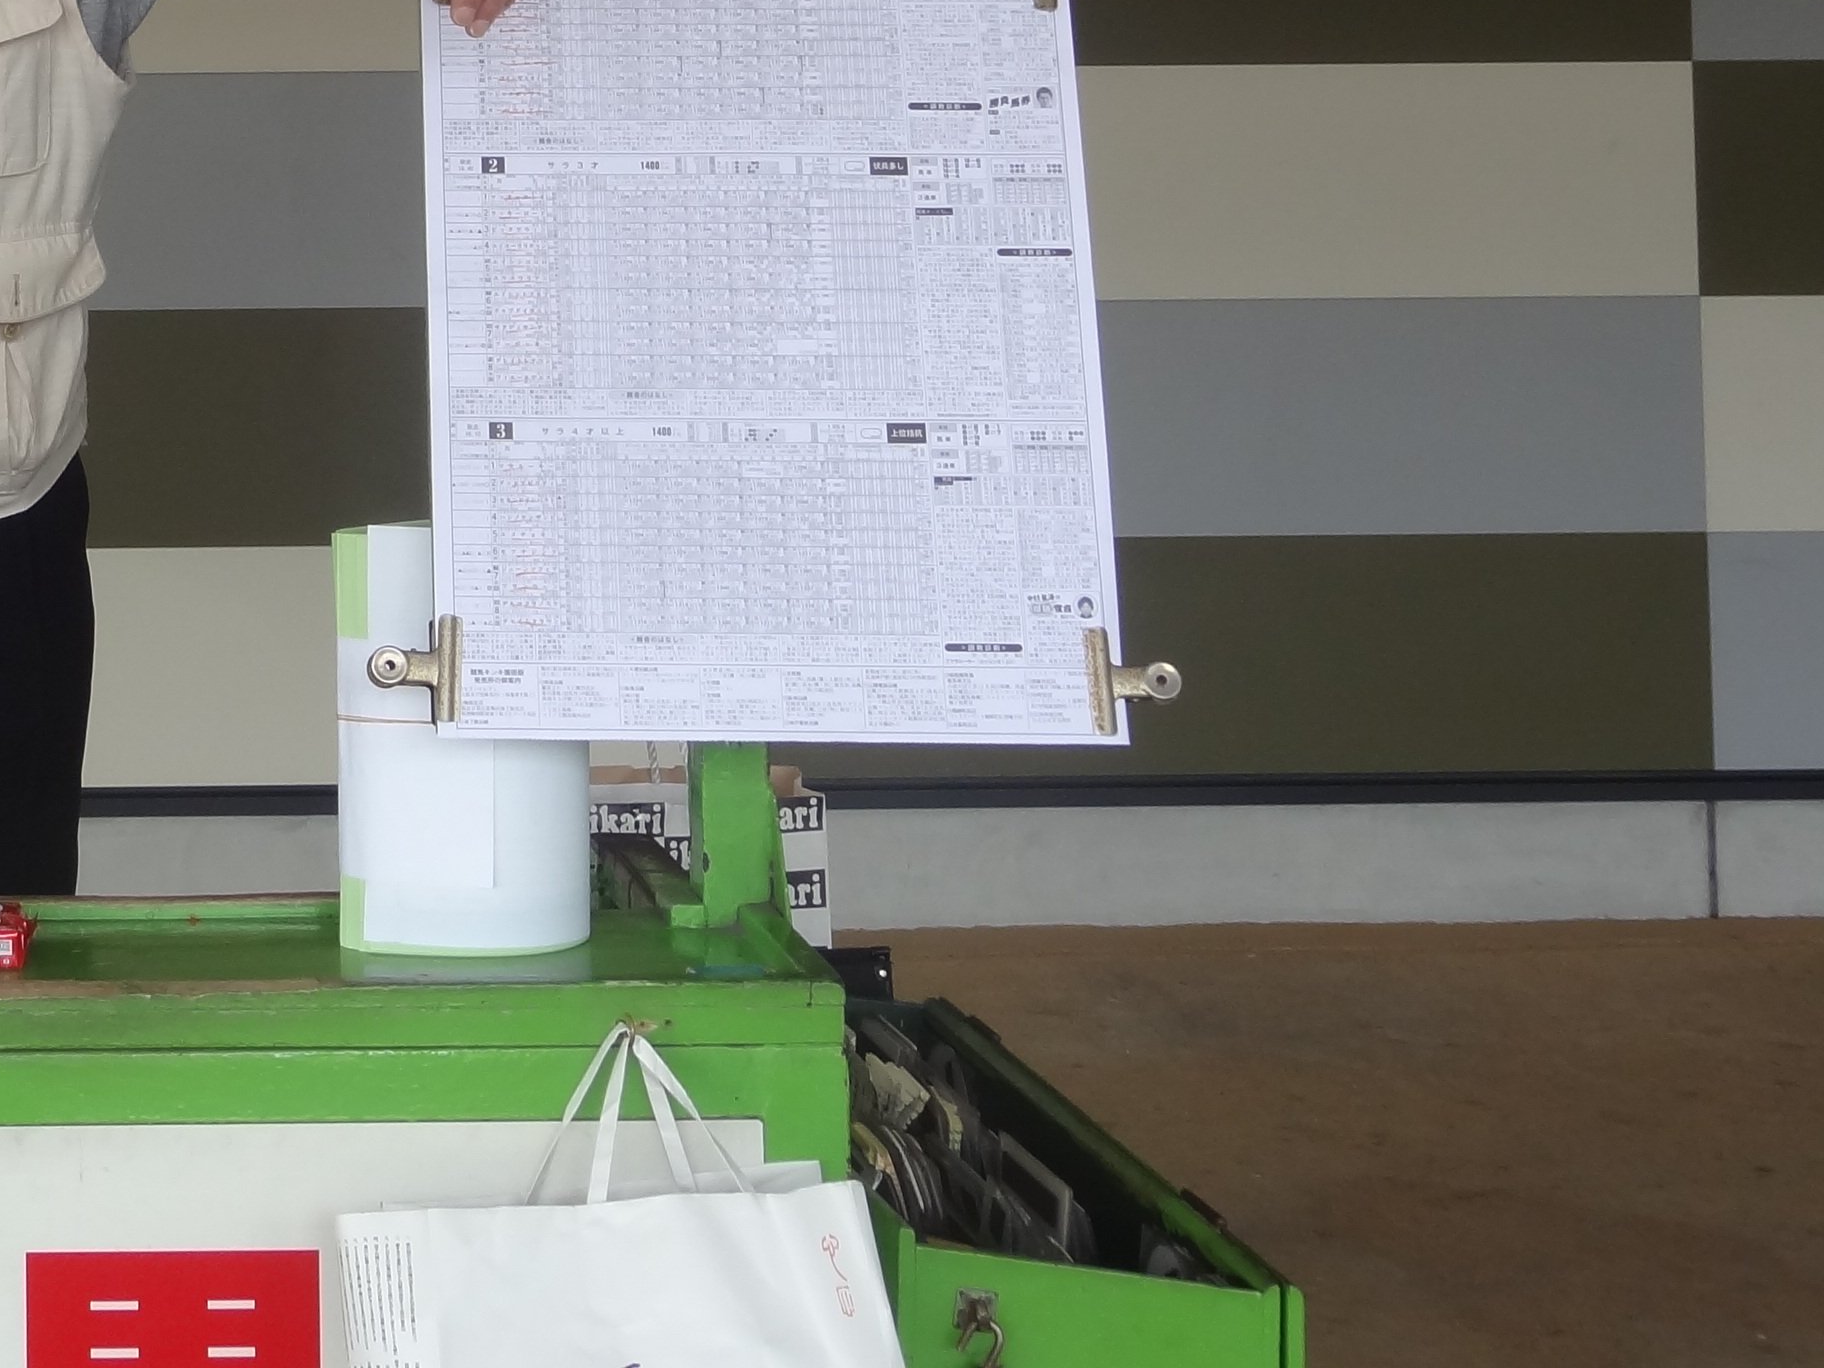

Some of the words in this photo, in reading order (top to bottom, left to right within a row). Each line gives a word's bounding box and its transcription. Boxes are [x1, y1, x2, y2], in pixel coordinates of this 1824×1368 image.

[488, 159, 499, 173] 2
[496, 423, 506, 439] 3
[779, 797, 819, 831] ari
